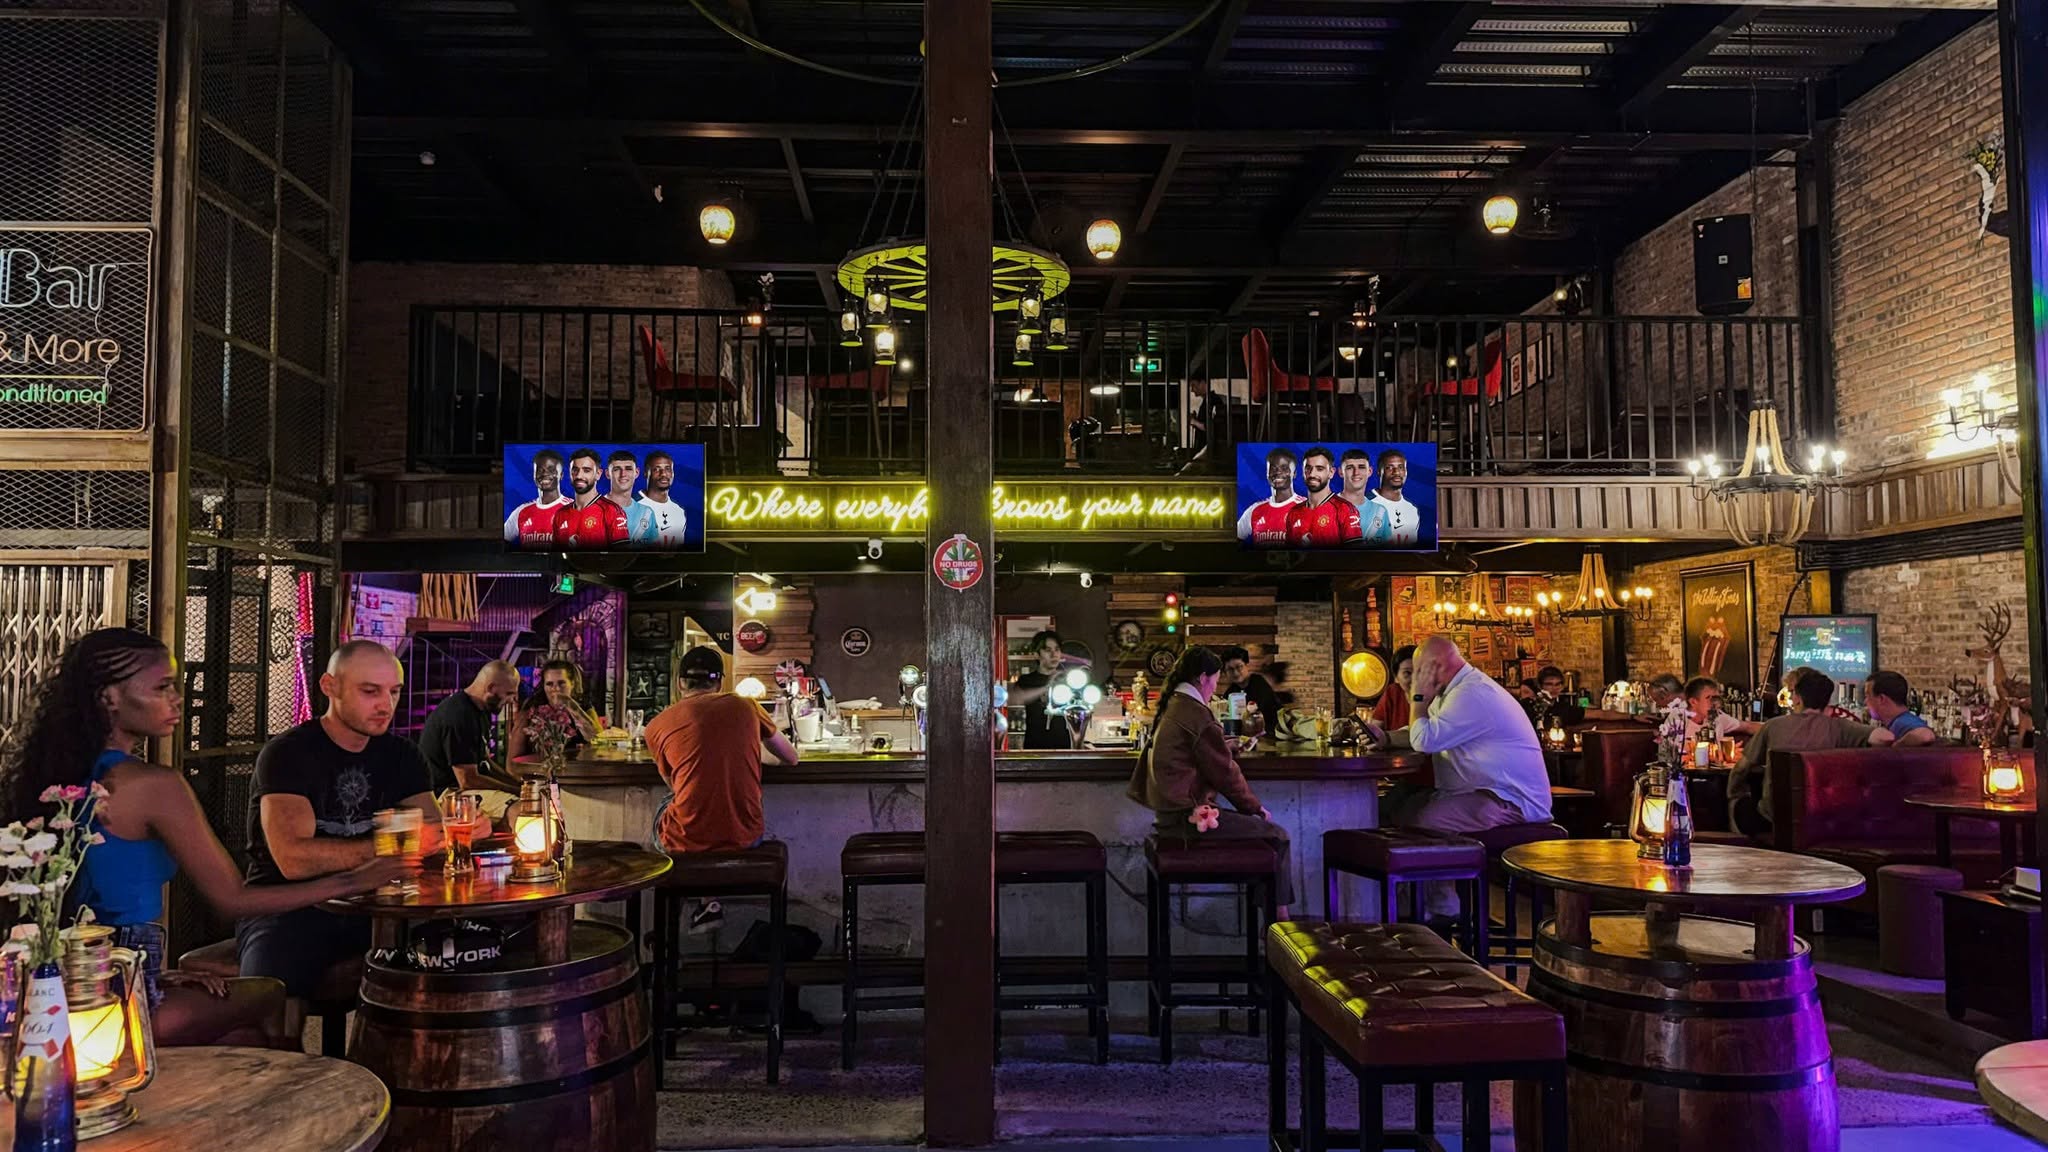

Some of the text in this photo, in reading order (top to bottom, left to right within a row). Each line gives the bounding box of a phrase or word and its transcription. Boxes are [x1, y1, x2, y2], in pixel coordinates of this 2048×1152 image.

[0, 249, 117, 311] Bar
[25, 334, 120, 364] More
[0, 383, 107, 404] nditioned
[711, 487, 825, 521] Where
[834, 487, 928, 532] everyb
[1081, 493, 1143, 530] your
[1149, 496, 1225, 517] name
